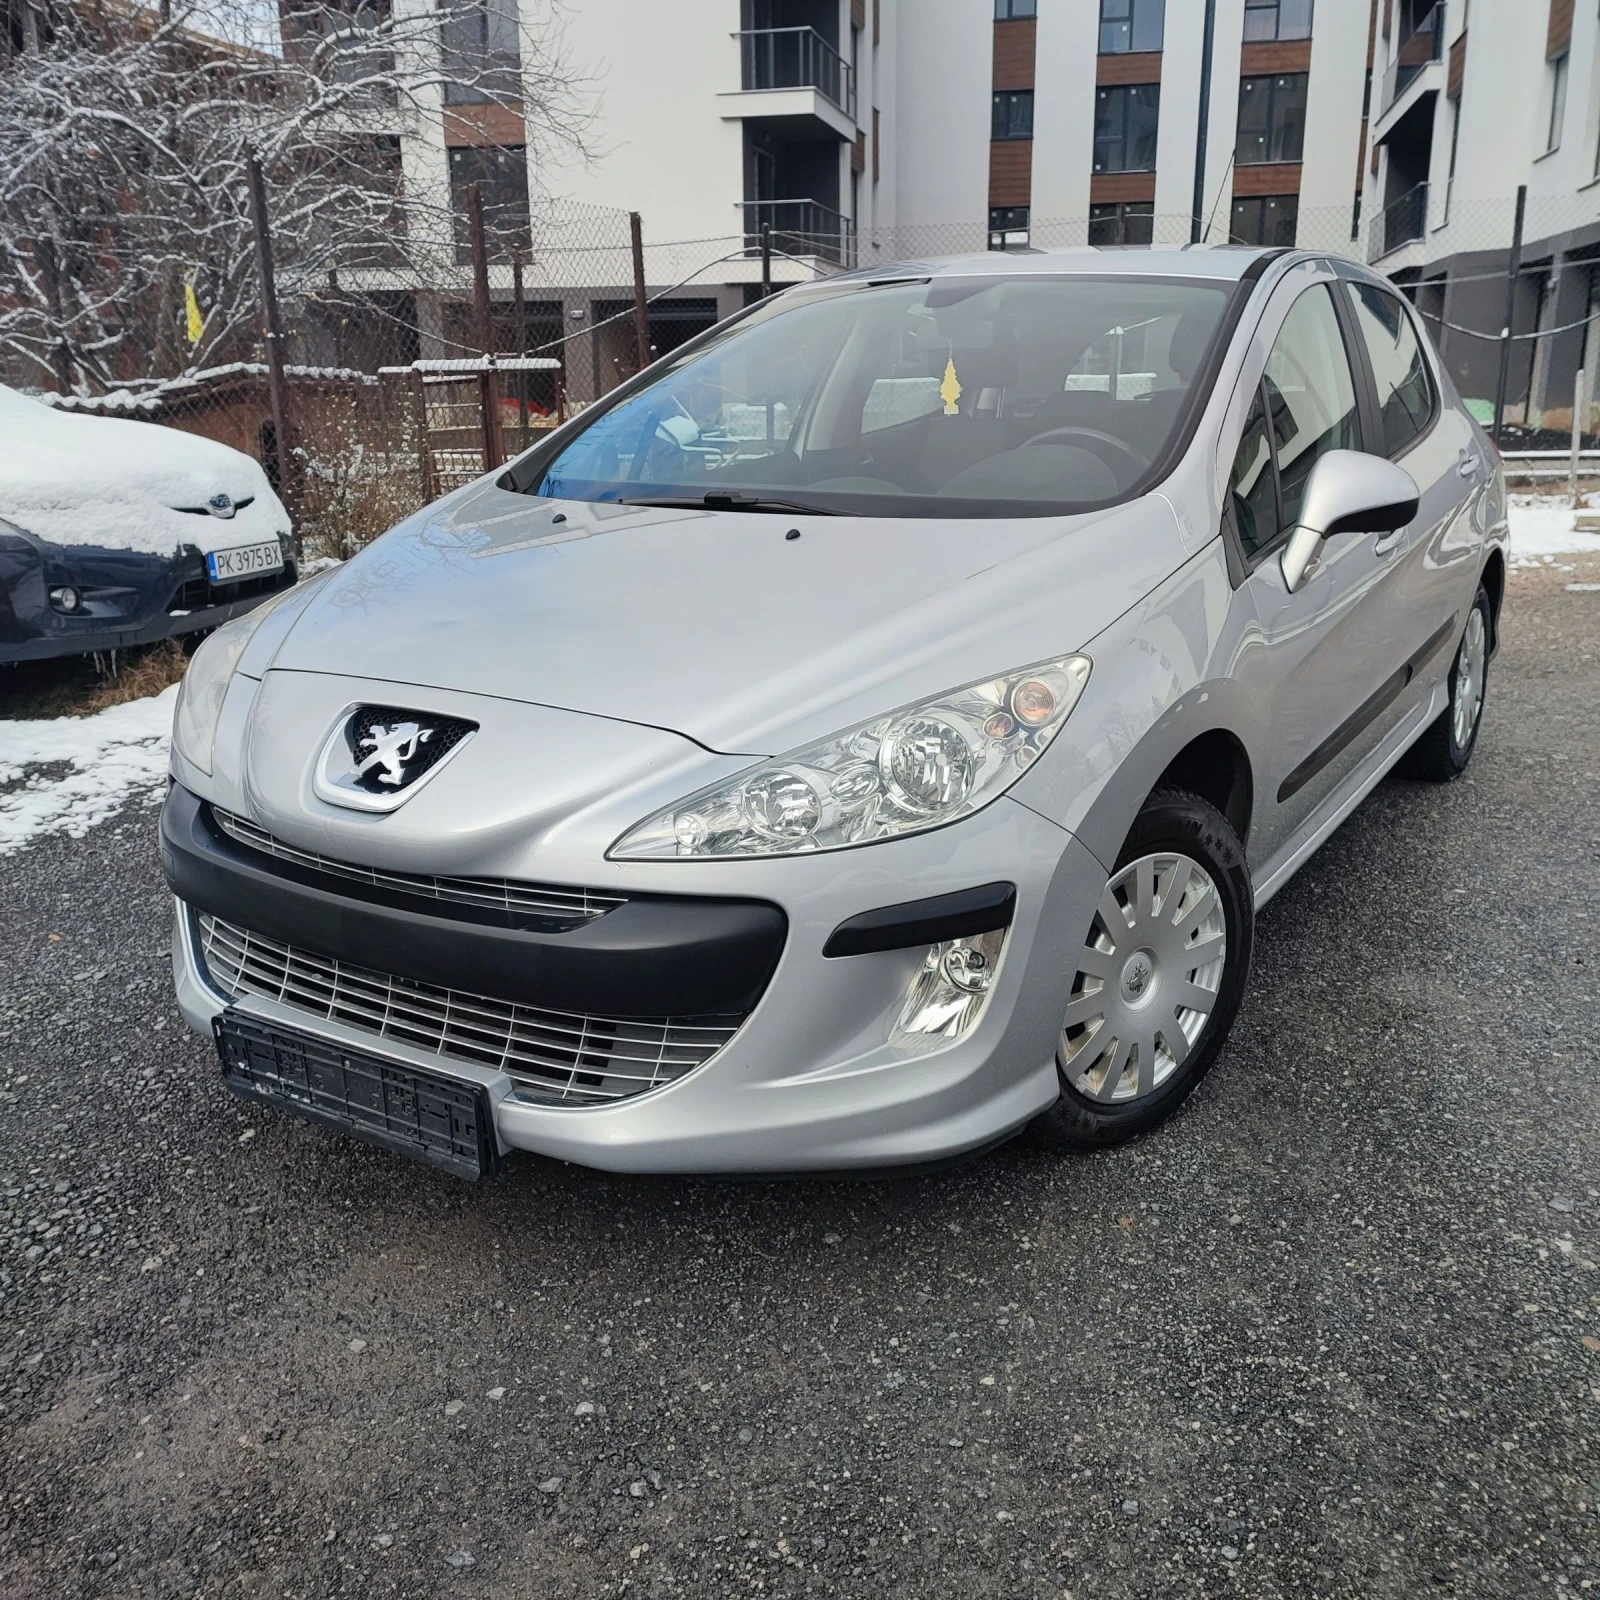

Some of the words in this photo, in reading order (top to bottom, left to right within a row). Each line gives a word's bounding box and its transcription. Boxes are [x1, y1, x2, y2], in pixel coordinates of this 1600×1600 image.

[217, 553, 234, 575] PK
[236, 548, 263, 571] 3975
[264, 545, 280, 566] BX
